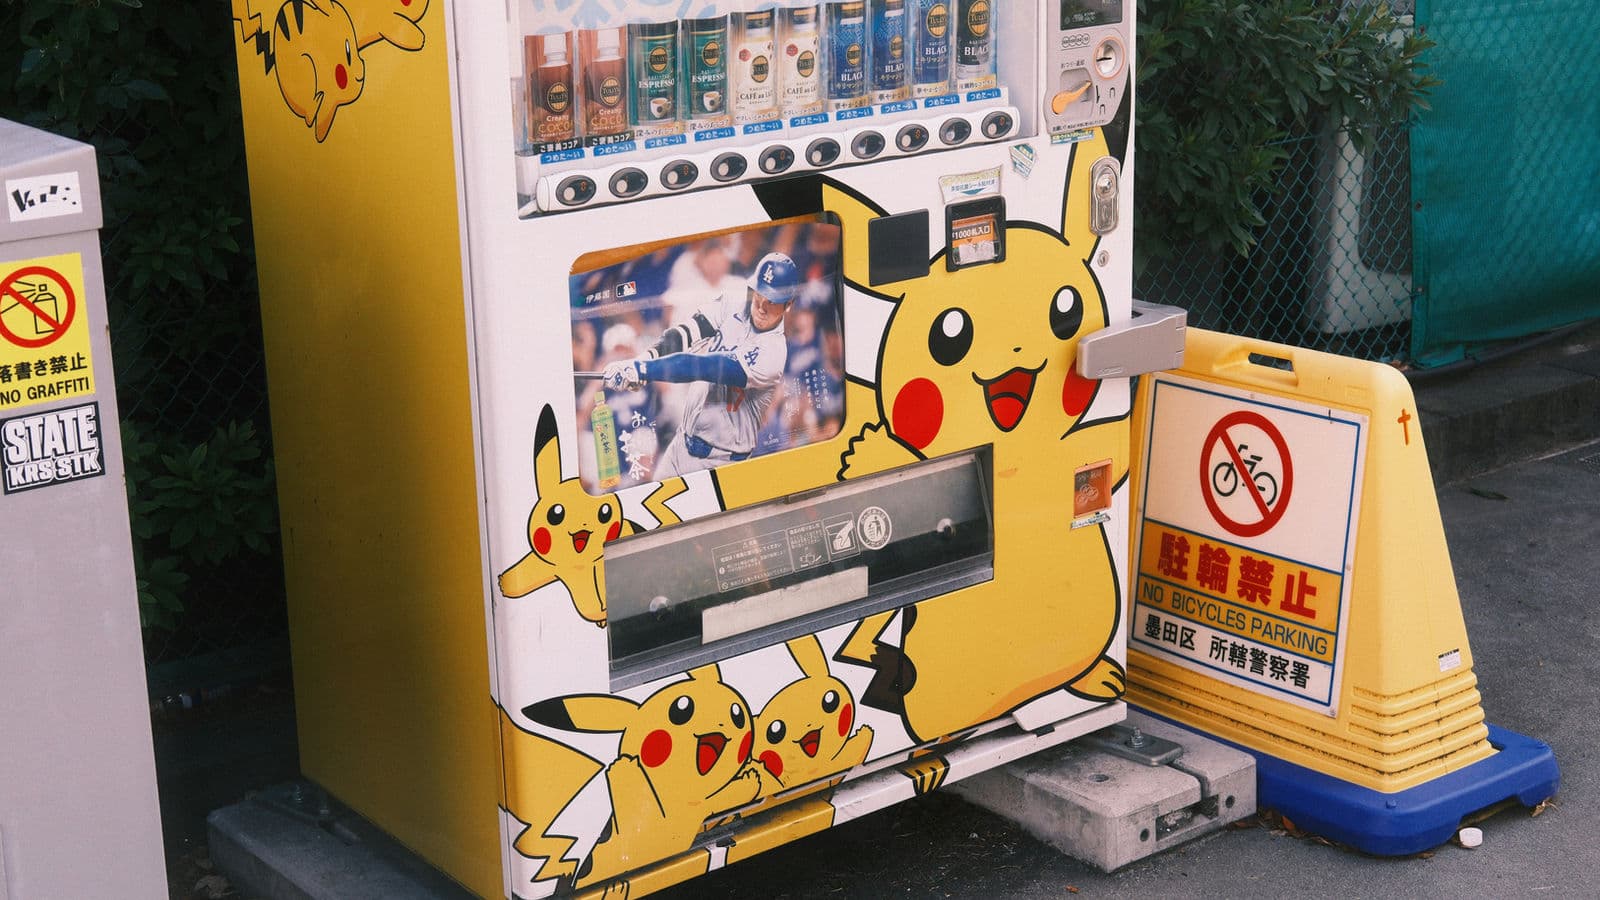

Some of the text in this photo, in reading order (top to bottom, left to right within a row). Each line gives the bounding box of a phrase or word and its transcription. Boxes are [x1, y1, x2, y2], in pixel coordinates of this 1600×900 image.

[0, 377, 90, 405] NO GRAFFITI
[2, 405, 98, 465] STATE
[8, 451, 101, 489] KRS STK
[1157, 532, 1317, 620] 駐輪禁止
[1143, 582, 1328, 656] NO BICYCLES PARKING
[1144, 613, 1311, 690] 墨田区 所轄警察署
